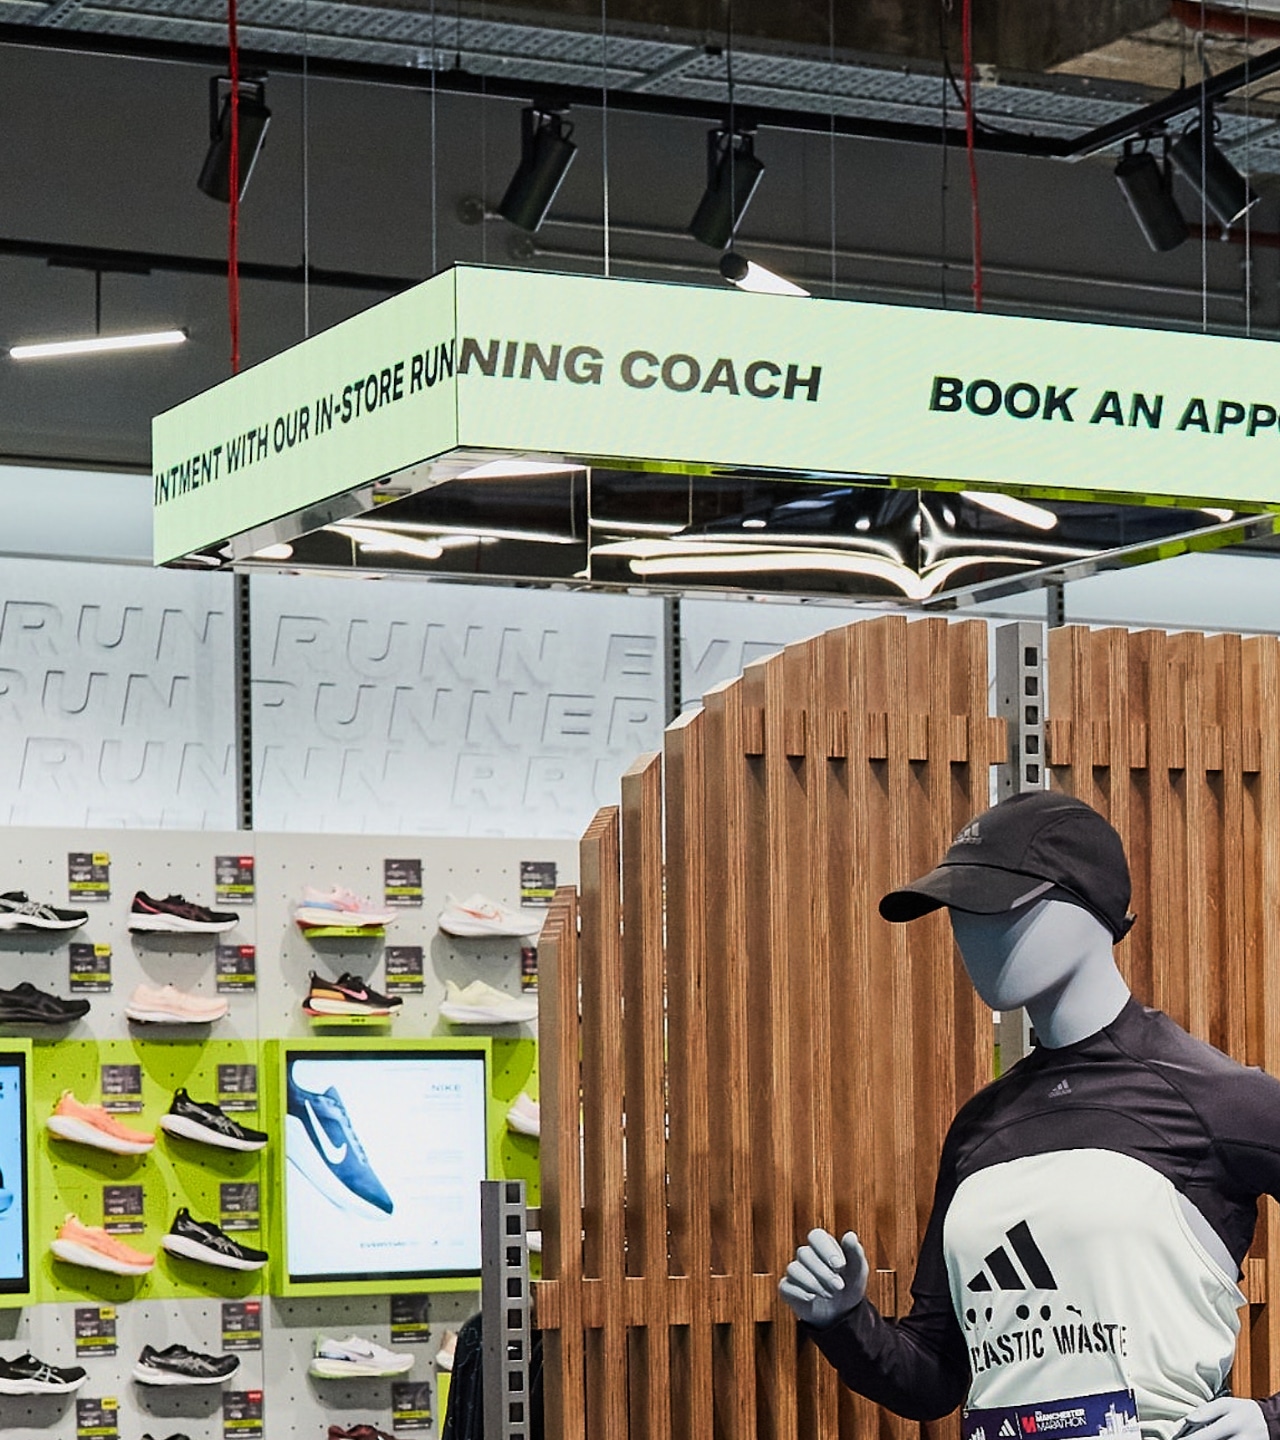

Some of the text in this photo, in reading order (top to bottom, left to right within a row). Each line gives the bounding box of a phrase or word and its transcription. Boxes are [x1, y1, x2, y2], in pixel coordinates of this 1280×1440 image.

[458, 337, 822, 404] NING COACH
[154, 338, 455, 507] INTMENT WITH OUR IN-STORE RUN
[928, 375, 1076, 424] BOOK
[1088, 389, 1165, 431] AN
[1037, 1417, 1087, 1432] MARATHON
